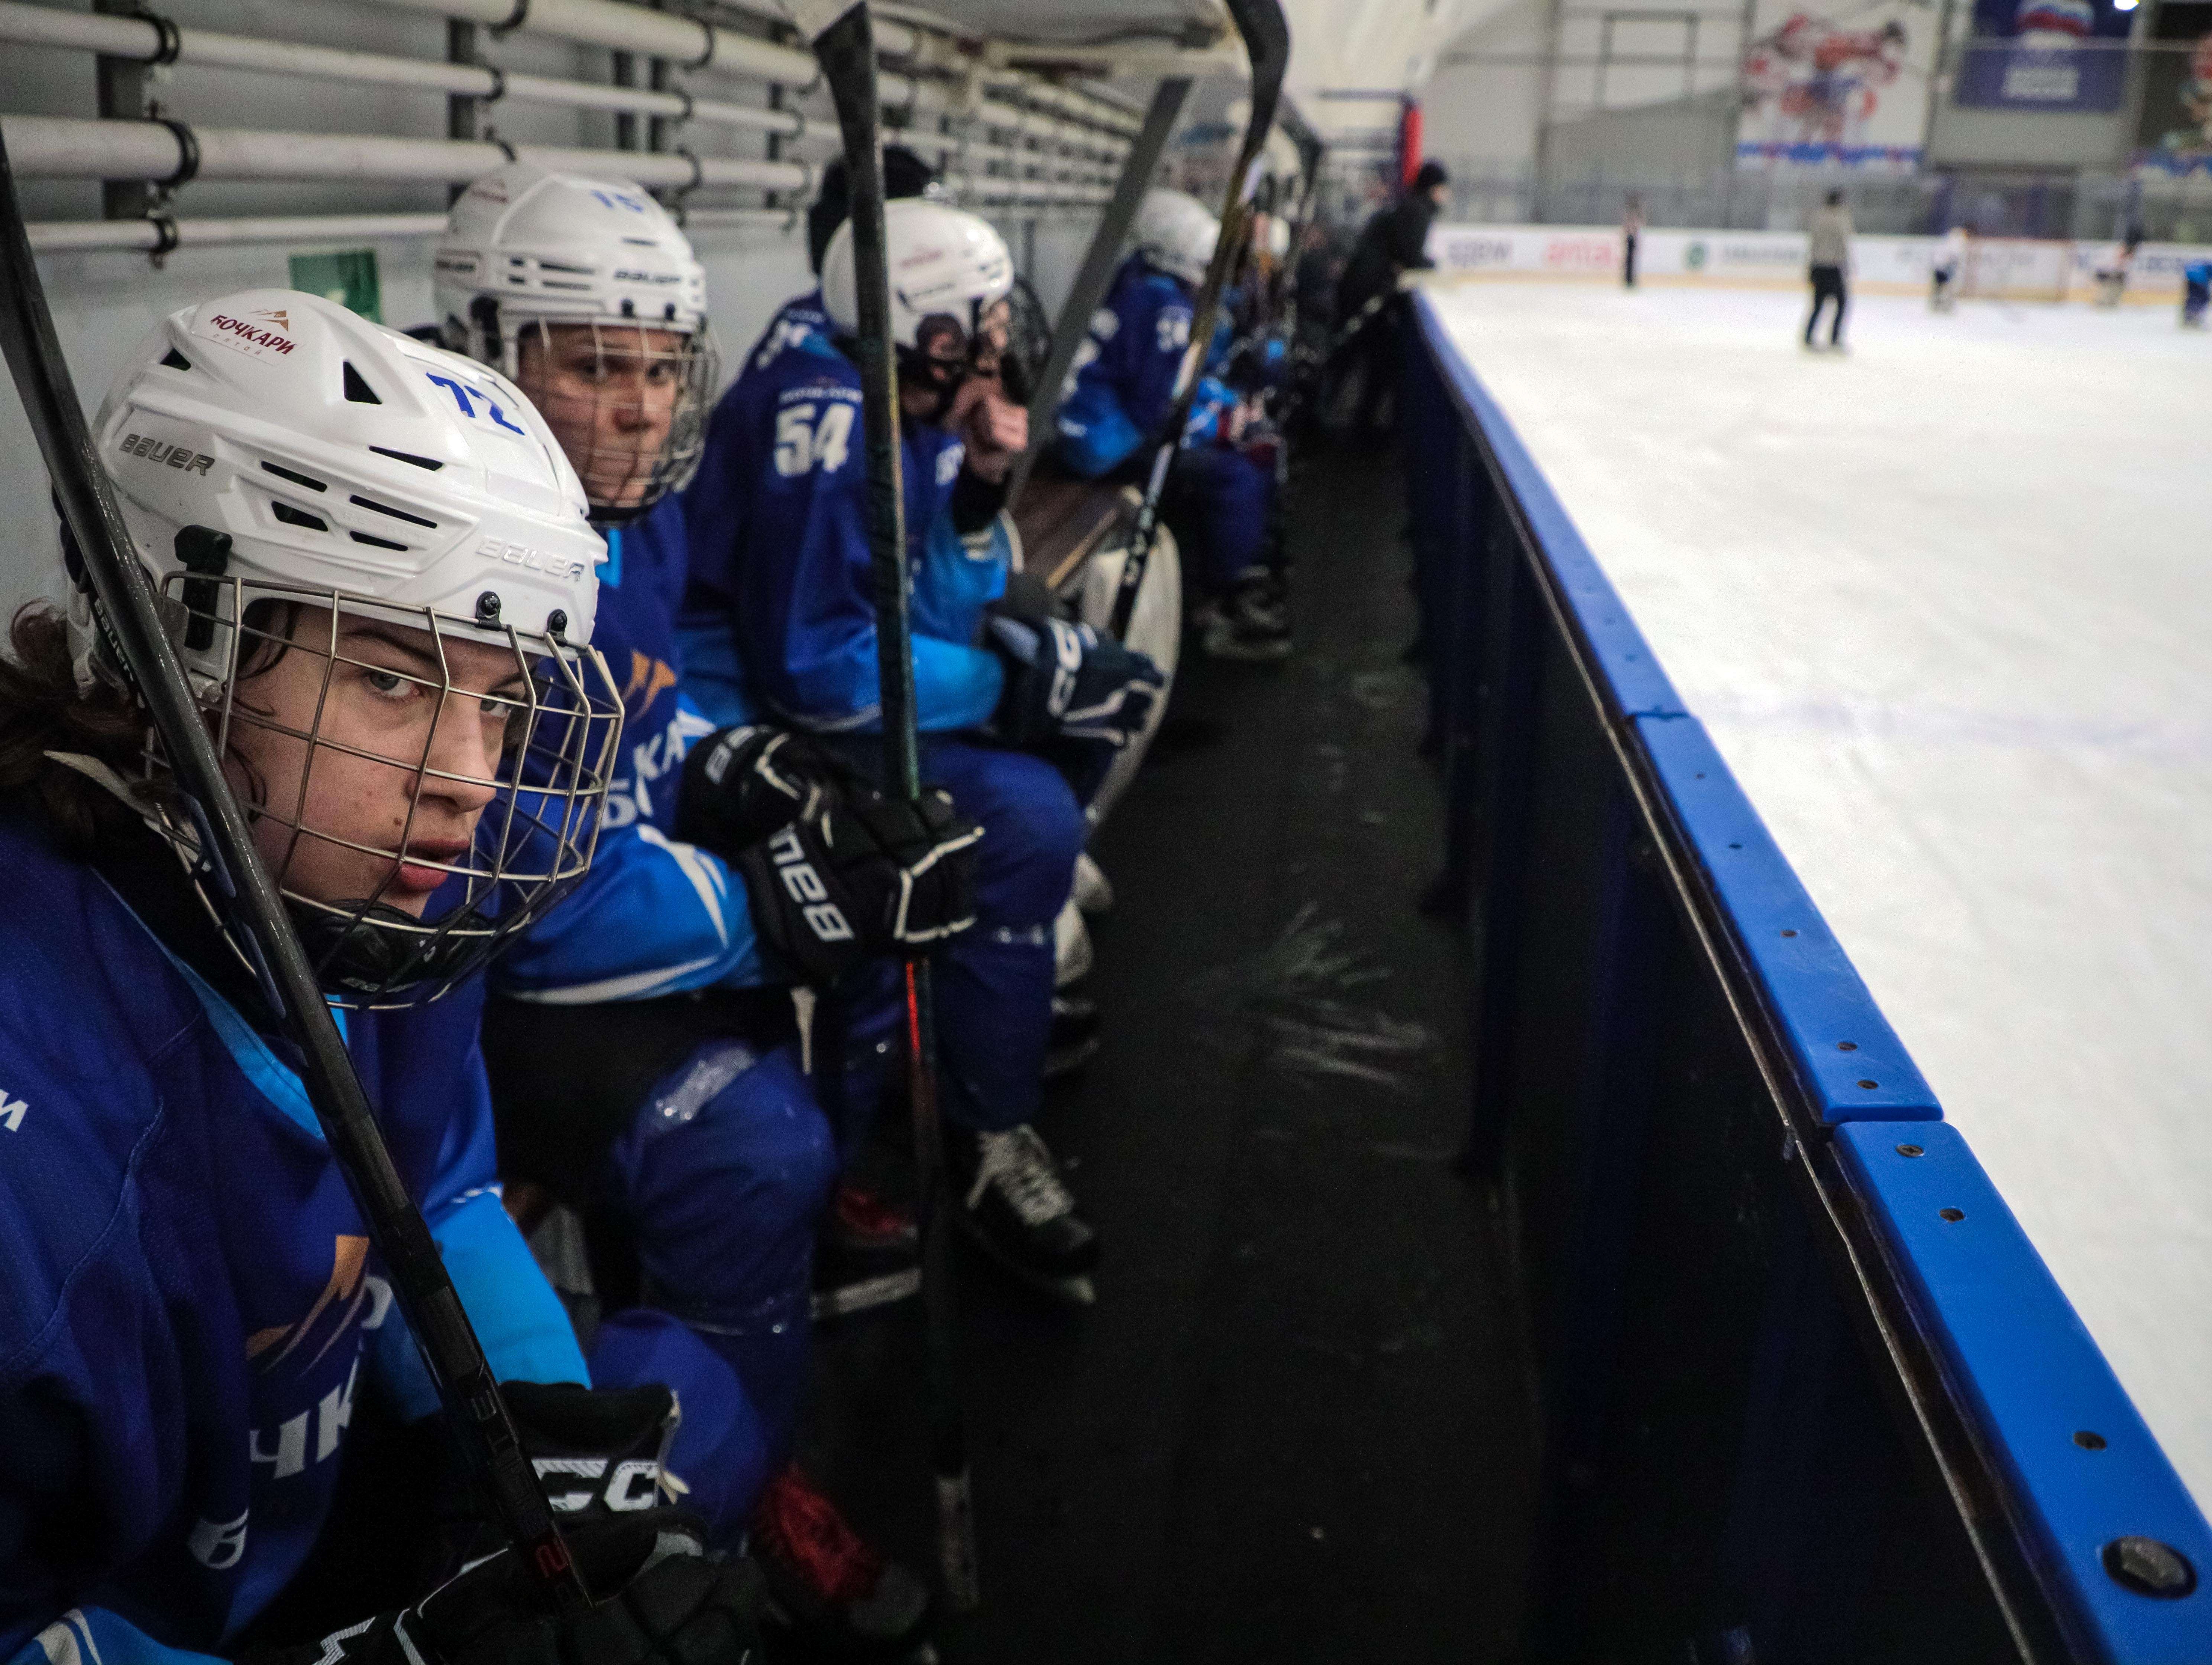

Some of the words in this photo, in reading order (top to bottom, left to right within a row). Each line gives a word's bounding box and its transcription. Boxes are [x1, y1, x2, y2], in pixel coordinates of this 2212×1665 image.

[210, 314, 297, 355] БОЧКАРИ
[426, 371, 525, 436] 72
[119, 433, 215, 476] BAUER
[774, 403, 855, 476] 54
[475, 535, 585, 582] BAUER
